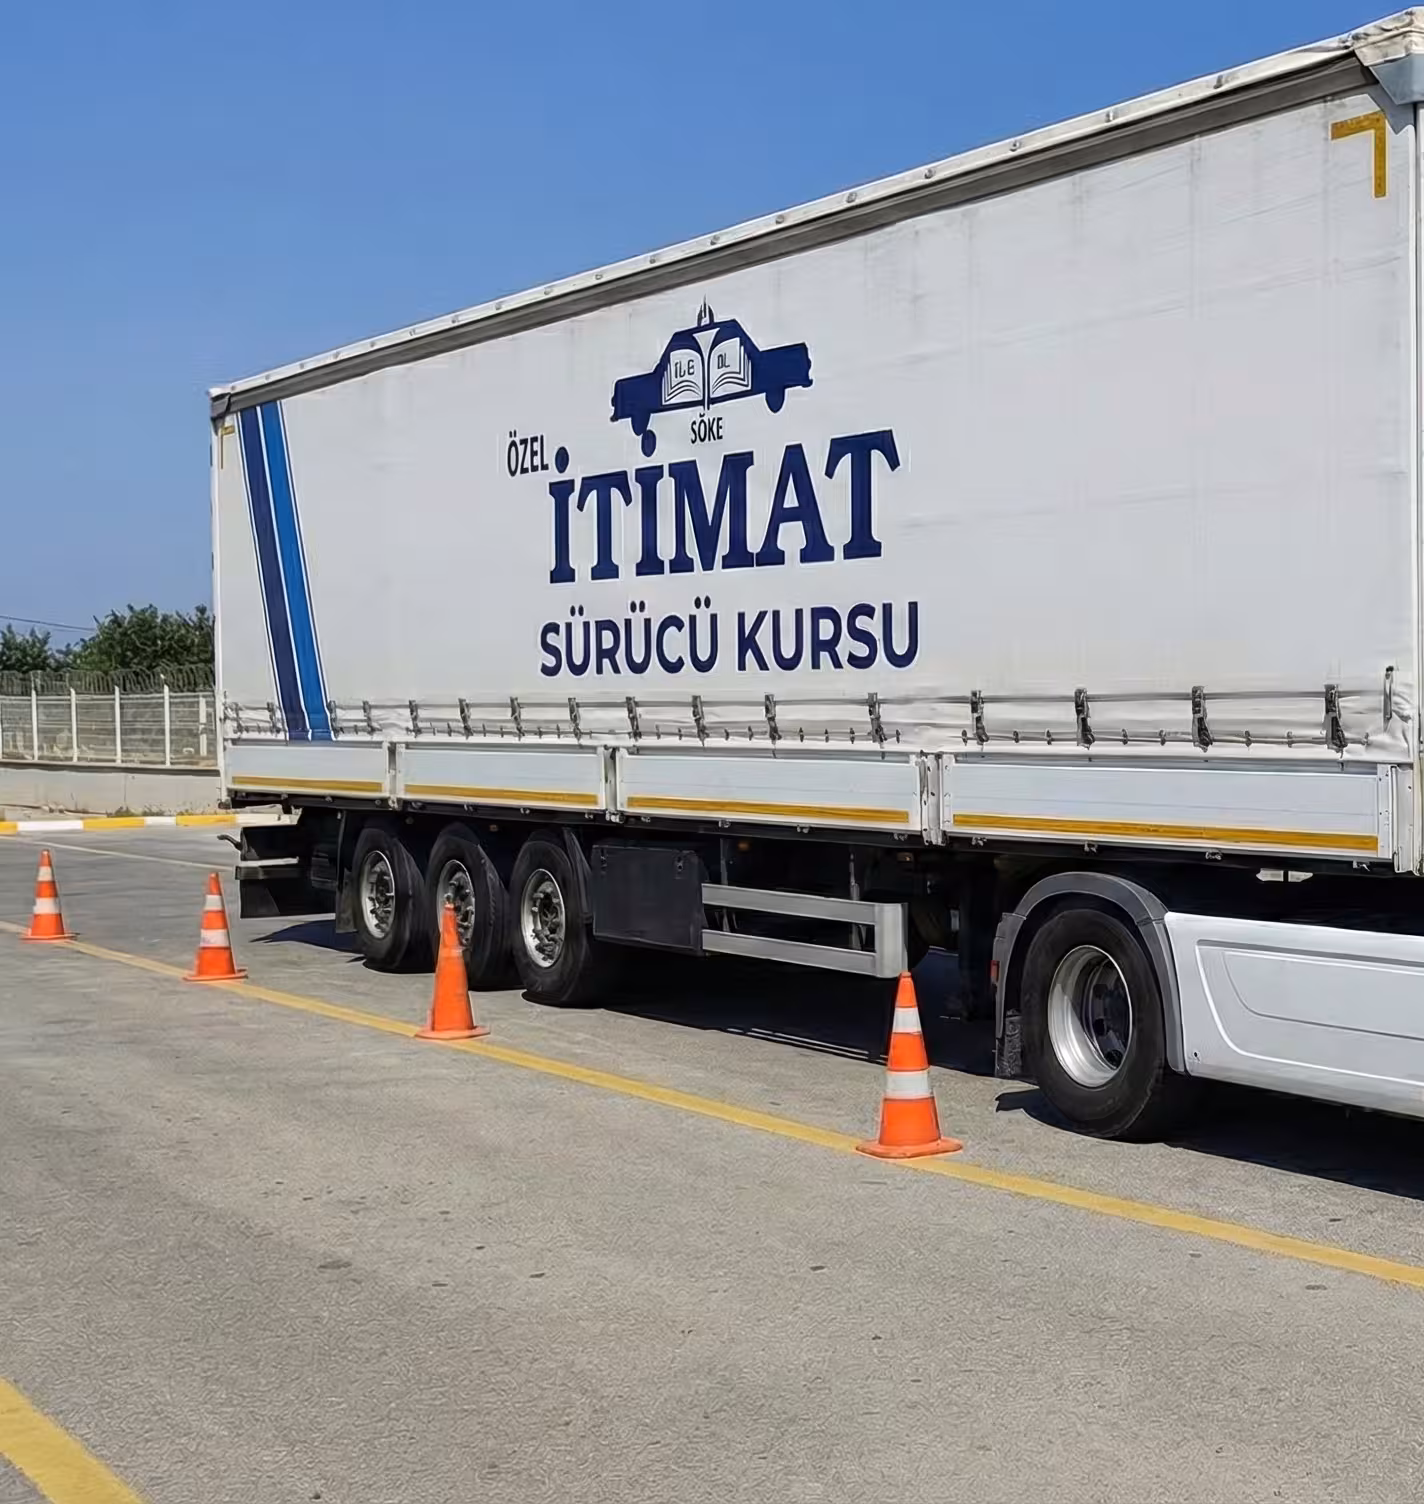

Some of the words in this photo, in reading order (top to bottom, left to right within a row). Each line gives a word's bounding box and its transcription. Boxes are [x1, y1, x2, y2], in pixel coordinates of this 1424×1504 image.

[507, 431, 549, 477] ÖZEL
[548, 429, 900, 584] İTİMAT
[540, 595, 719, 677] SÜRÜCÜ
[737, 601, 919, 672] KURSU
